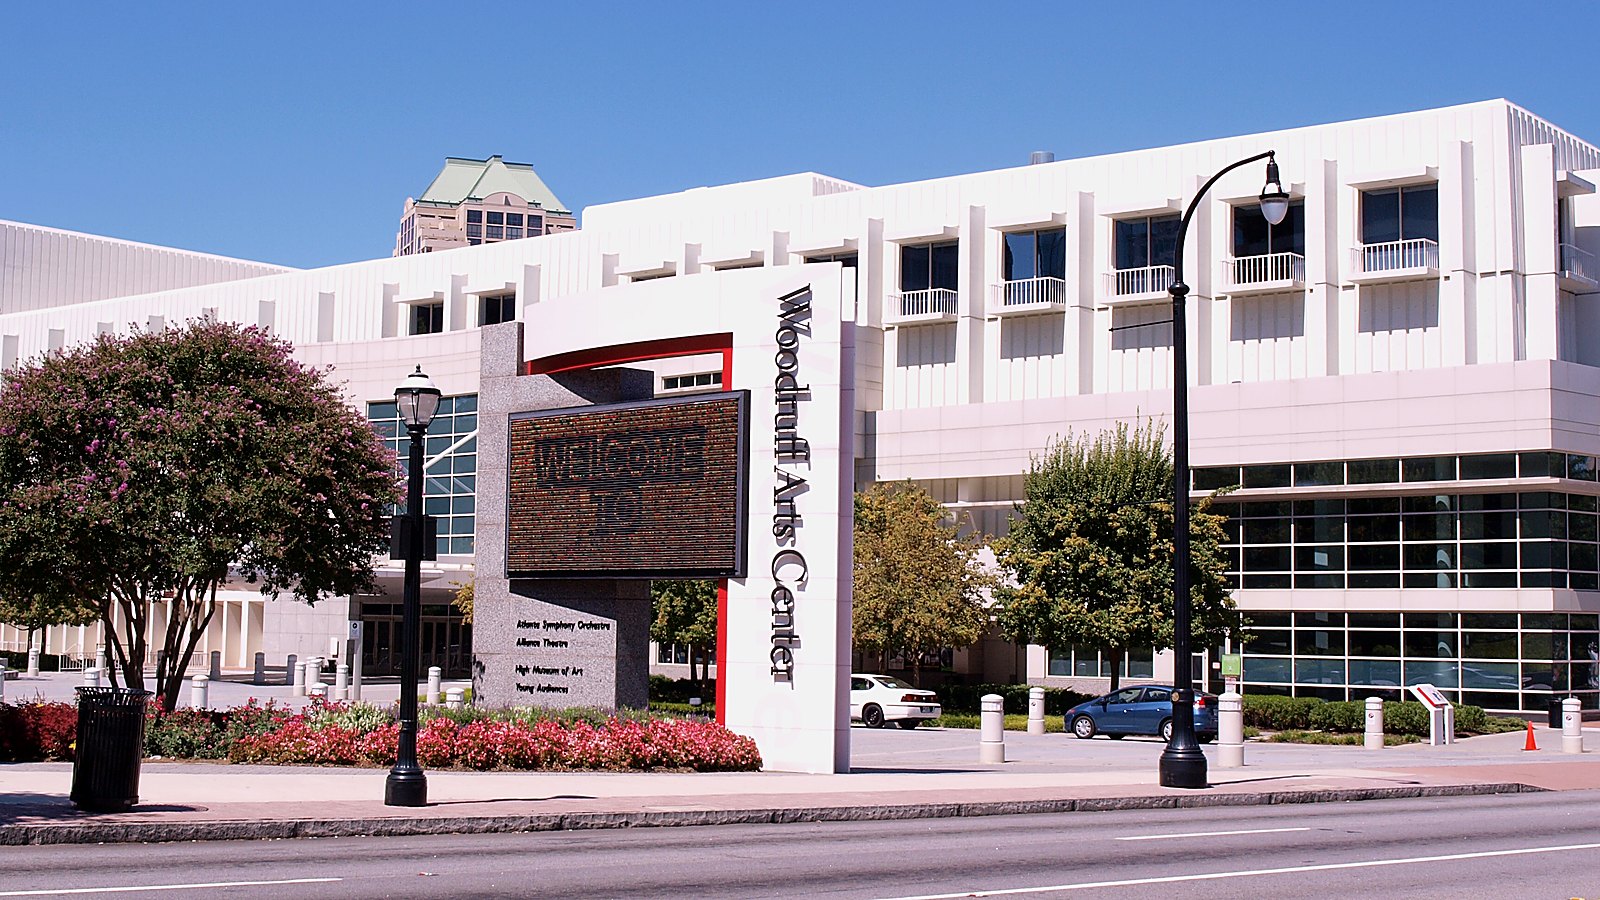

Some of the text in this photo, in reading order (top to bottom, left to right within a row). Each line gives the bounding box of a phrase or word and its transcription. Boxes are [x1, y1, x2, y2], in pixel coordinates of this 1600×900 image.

[536, 430, 703, 484] WELCOME
[770, 283, 811, 681] Woodruff Arts Center
[591, 487, 641, 531] TO
[517, 620, 610, 632] Atlanta Symphony Orchestra
[516, 638, 568, 648] Alliance Theatre
[515, 665, 583, 677] High Museum of Art
[516, 683, 568, 694] Young Audiences
